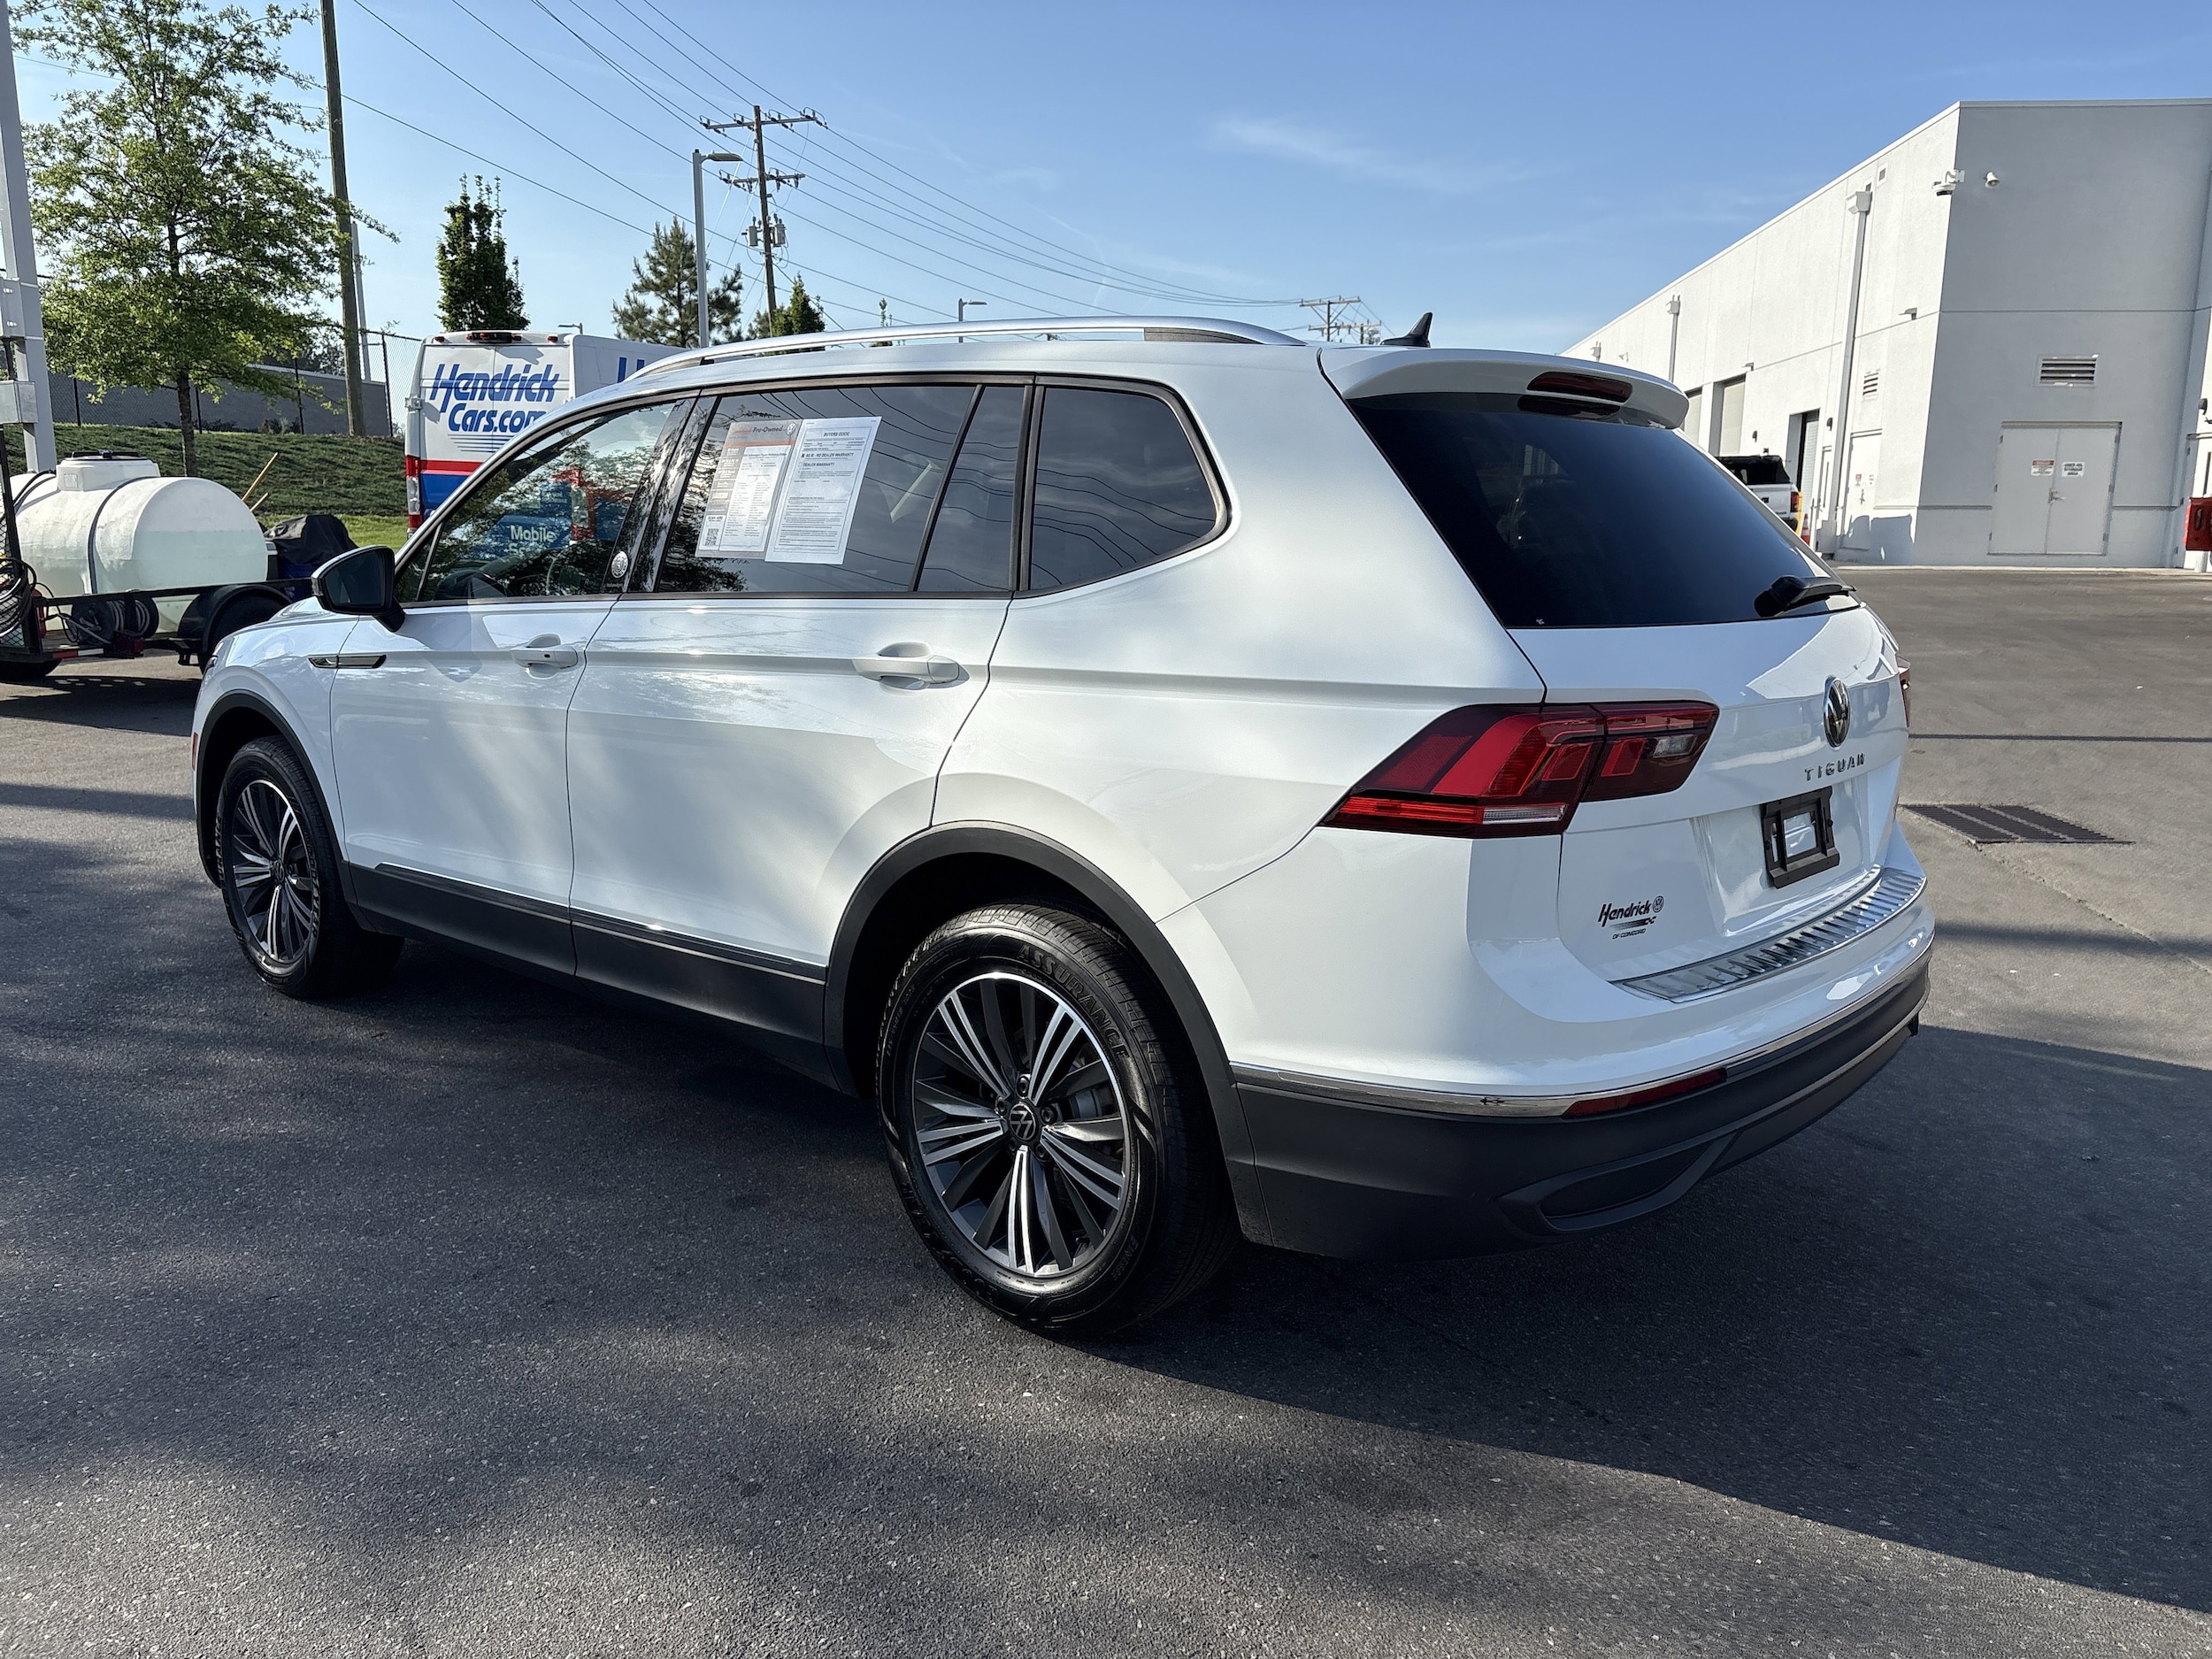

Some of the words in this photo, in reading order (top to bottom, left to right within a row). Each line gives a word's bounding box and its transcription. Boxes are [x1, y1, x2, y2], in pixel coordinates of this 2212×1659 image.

[429, 364, 560, 413] Hendrick
[510, 525, 557, 543] Mobile
[1804, 752, 1865, 781] TIGUAN
[1597, 899, 1652, 928] Hendrick
[1016, 944, 1131, 1060] ASSURANCE
